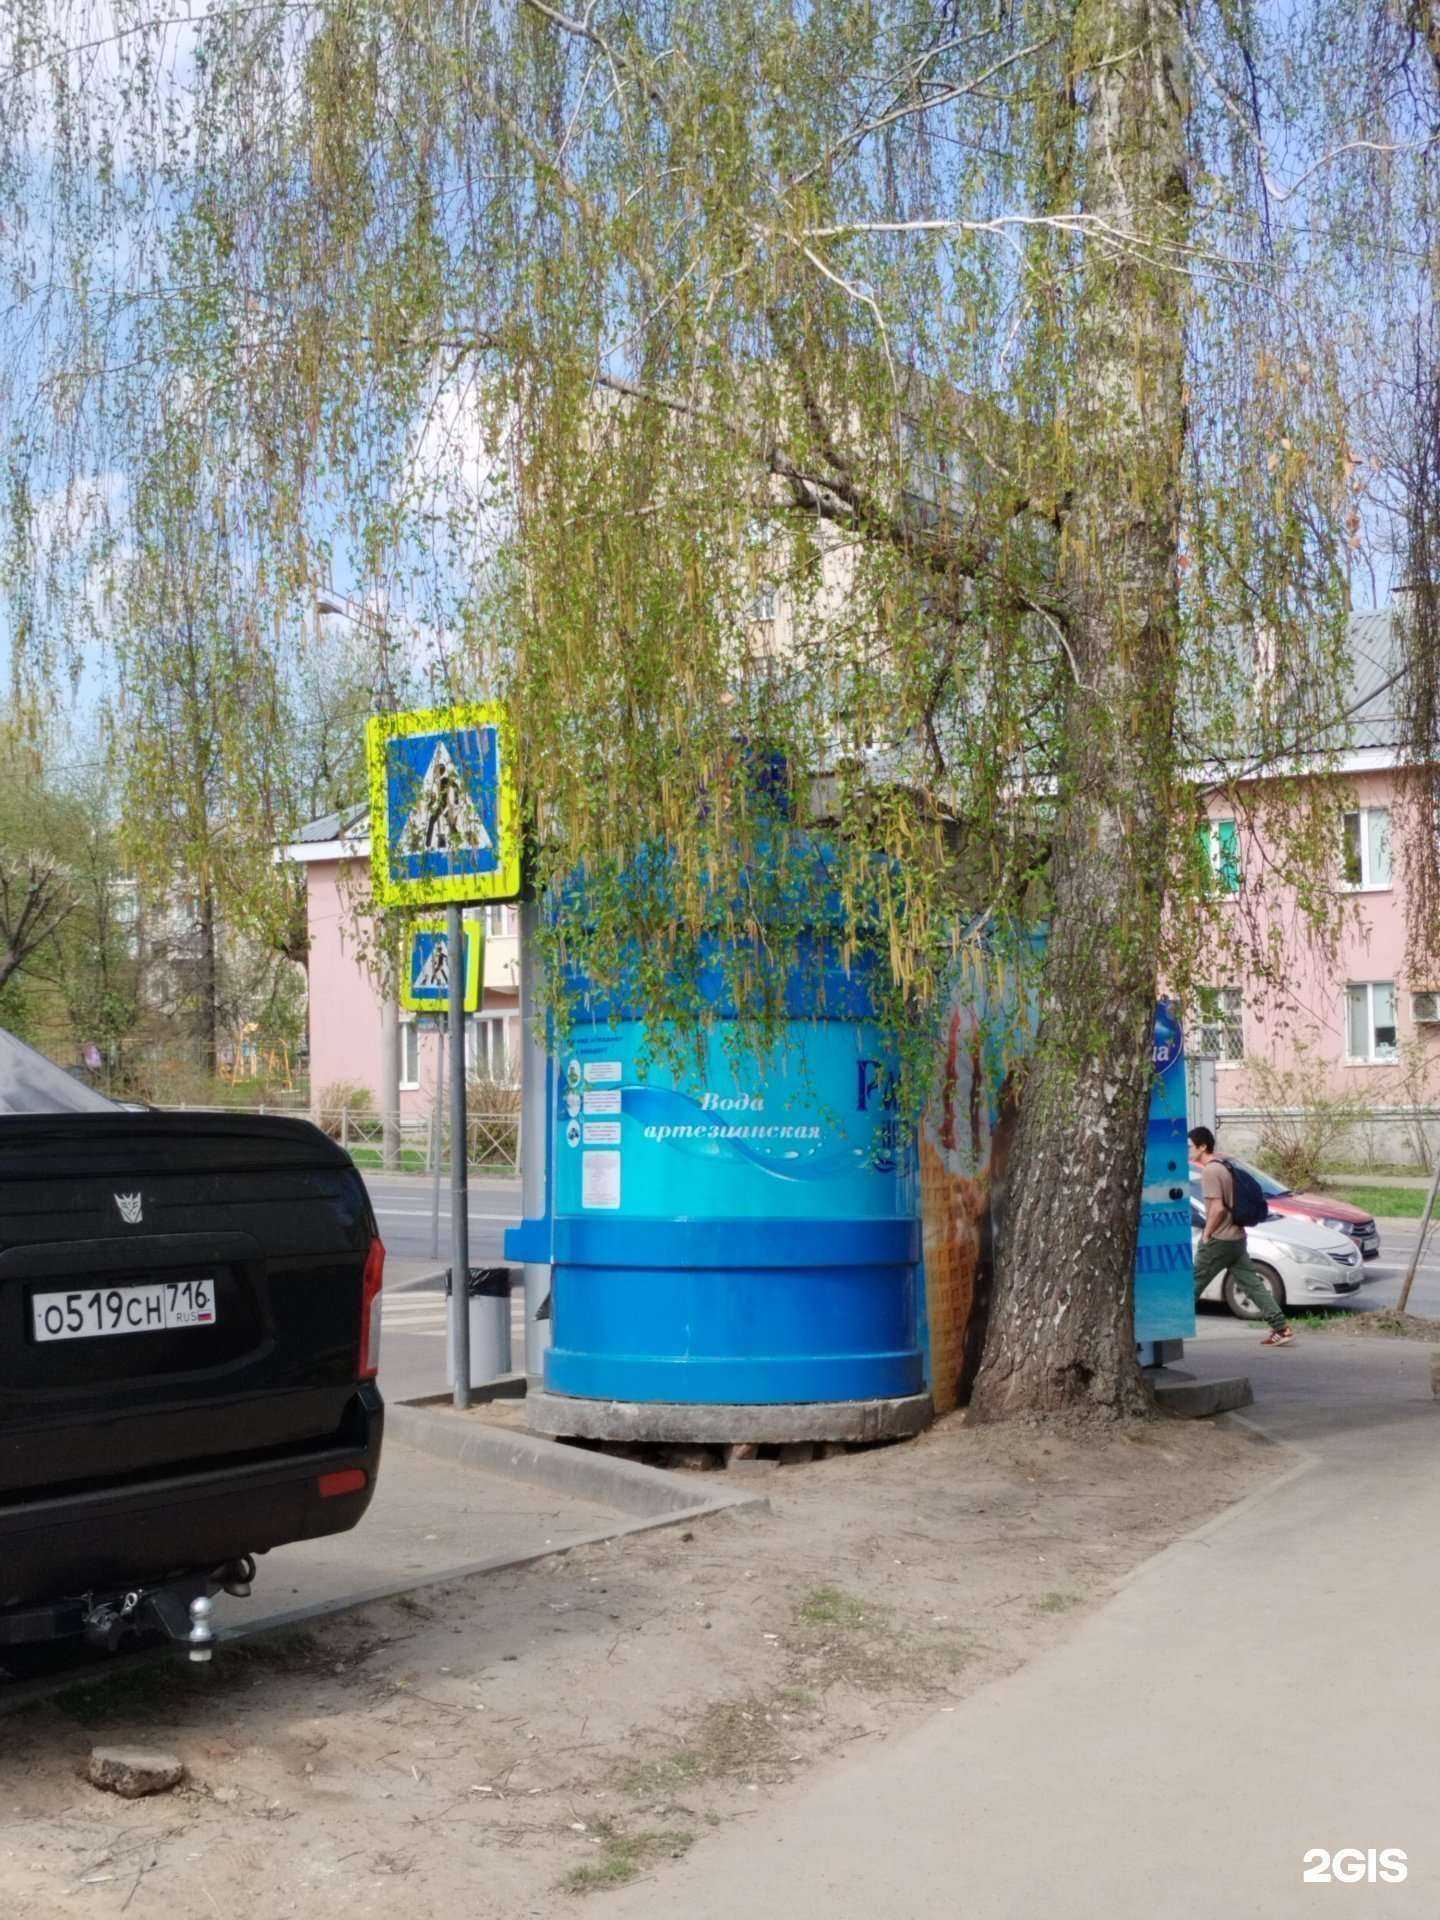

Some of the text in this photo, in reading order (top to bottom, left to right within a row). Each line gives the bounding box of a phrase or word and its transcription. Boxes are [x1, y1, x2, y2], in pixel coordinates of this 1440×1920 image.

[702, 1092, 765, 1111] Вода
[643, 1123, 821, 1143] артезианская
[166, 1281, 208, 1313] 716
[176, 1311, 197, 1323] RUS
